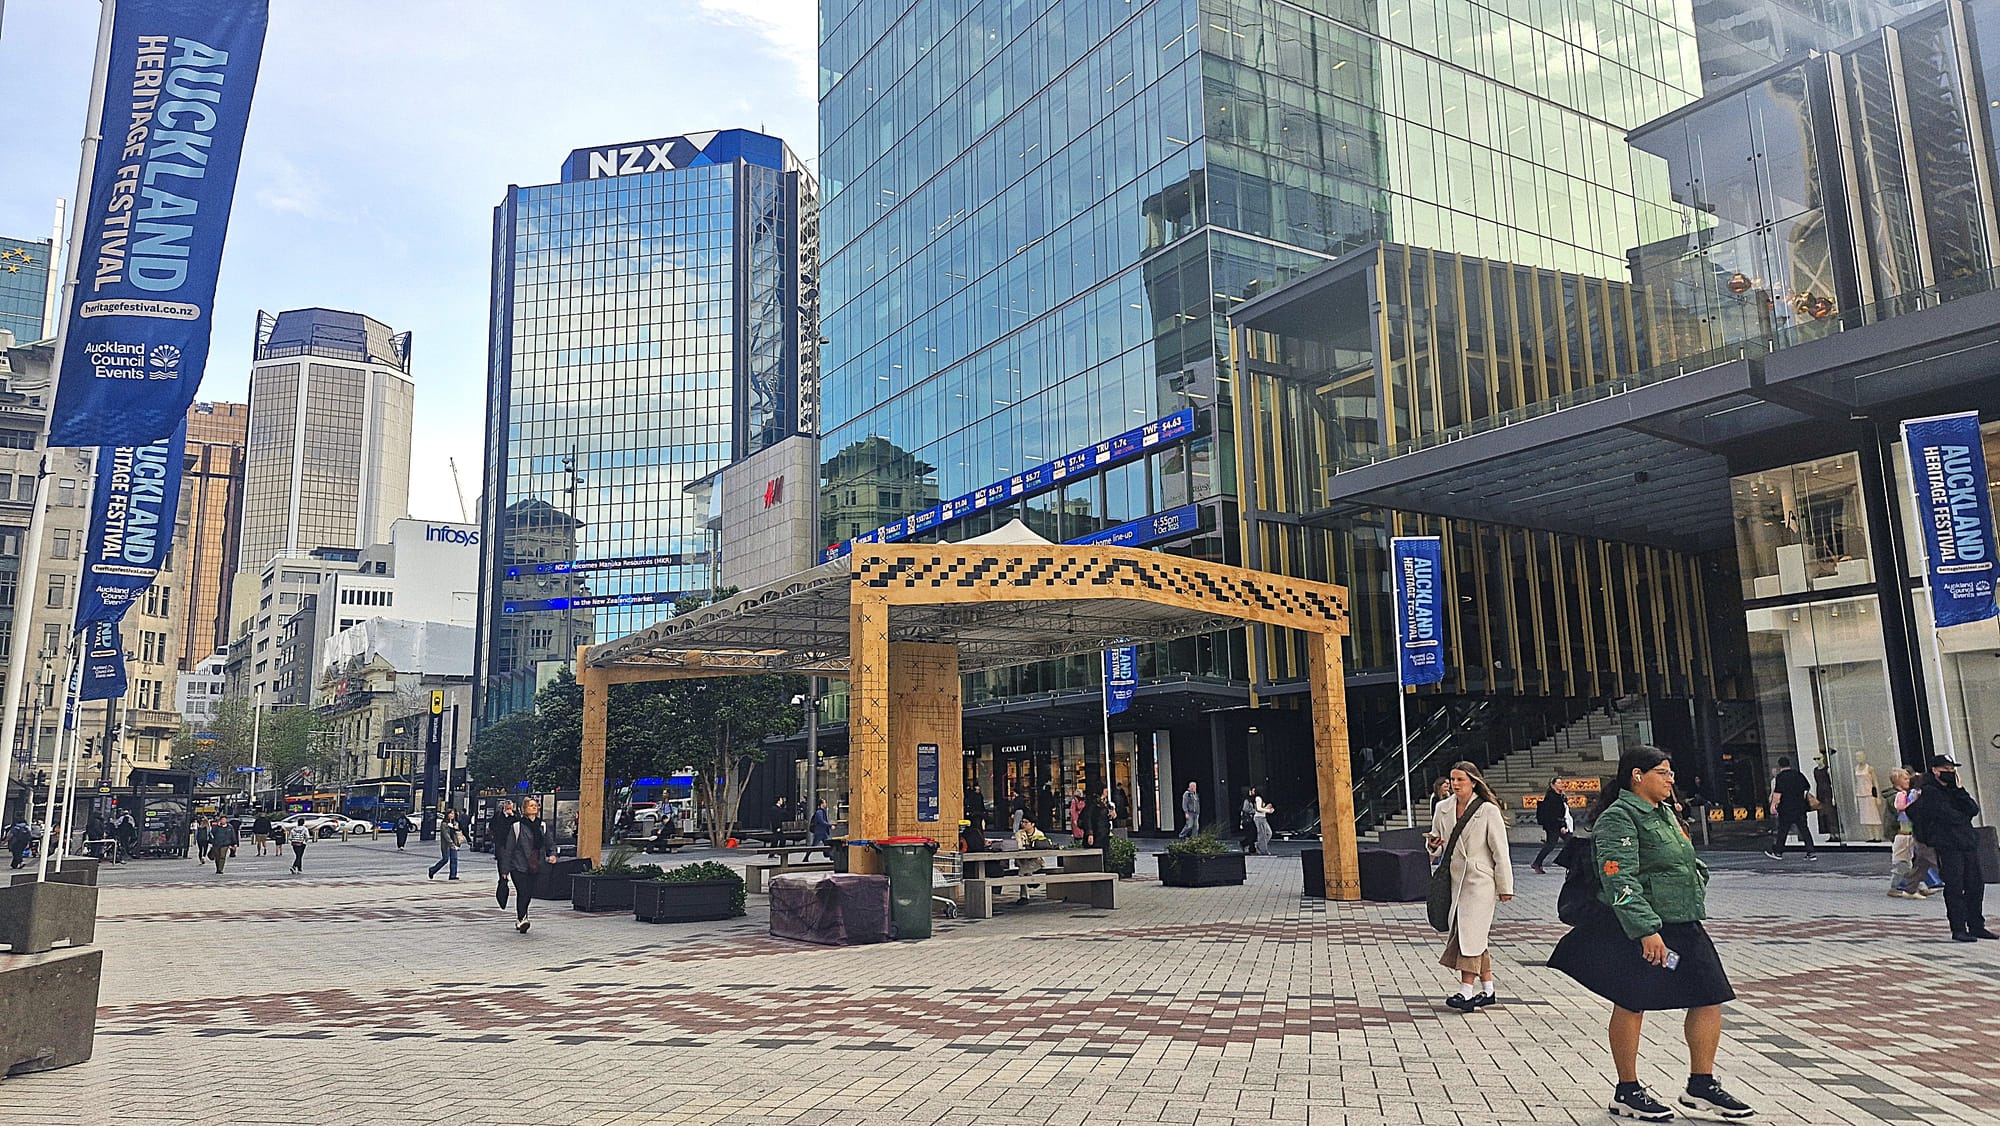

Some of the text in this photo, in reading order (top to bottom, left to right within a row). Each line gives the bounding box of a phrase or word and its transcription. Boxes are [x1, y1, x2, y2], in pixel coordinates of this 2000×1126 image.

[94, 36, 168, 292] HERITAGE FESTIVAL
[129, 37, 229, 291] AUCKLAND
[589, 141, 675, 179] NZX
[85, 302, 193, 316] heritagefestival.co.nz
[84, 341, 145, 354] Auckland
[91, 353, 144, 367] Council
[95, 366, 144, 379] Events
[1142, 423, 1158, 435] TWF
[102, 446, 134, 560] RITAGE FESTIVAL
[124, 438, 169, 564] UCKLAND
[1923, 446, 1956, 563] HERITAGE FESTIVAL
[1941, 445, 1985, 561] AUCKLAND
[426, 524, 479, 547] Infosys
[1153, 515, 1179, 529] 4:55pm
[1403, 557, 1418, 640] HERITAGE FESTIVAL
[1415, 558, 1433, 639] AUCKLAND
[1001, 740, 1027, 749] COACH
